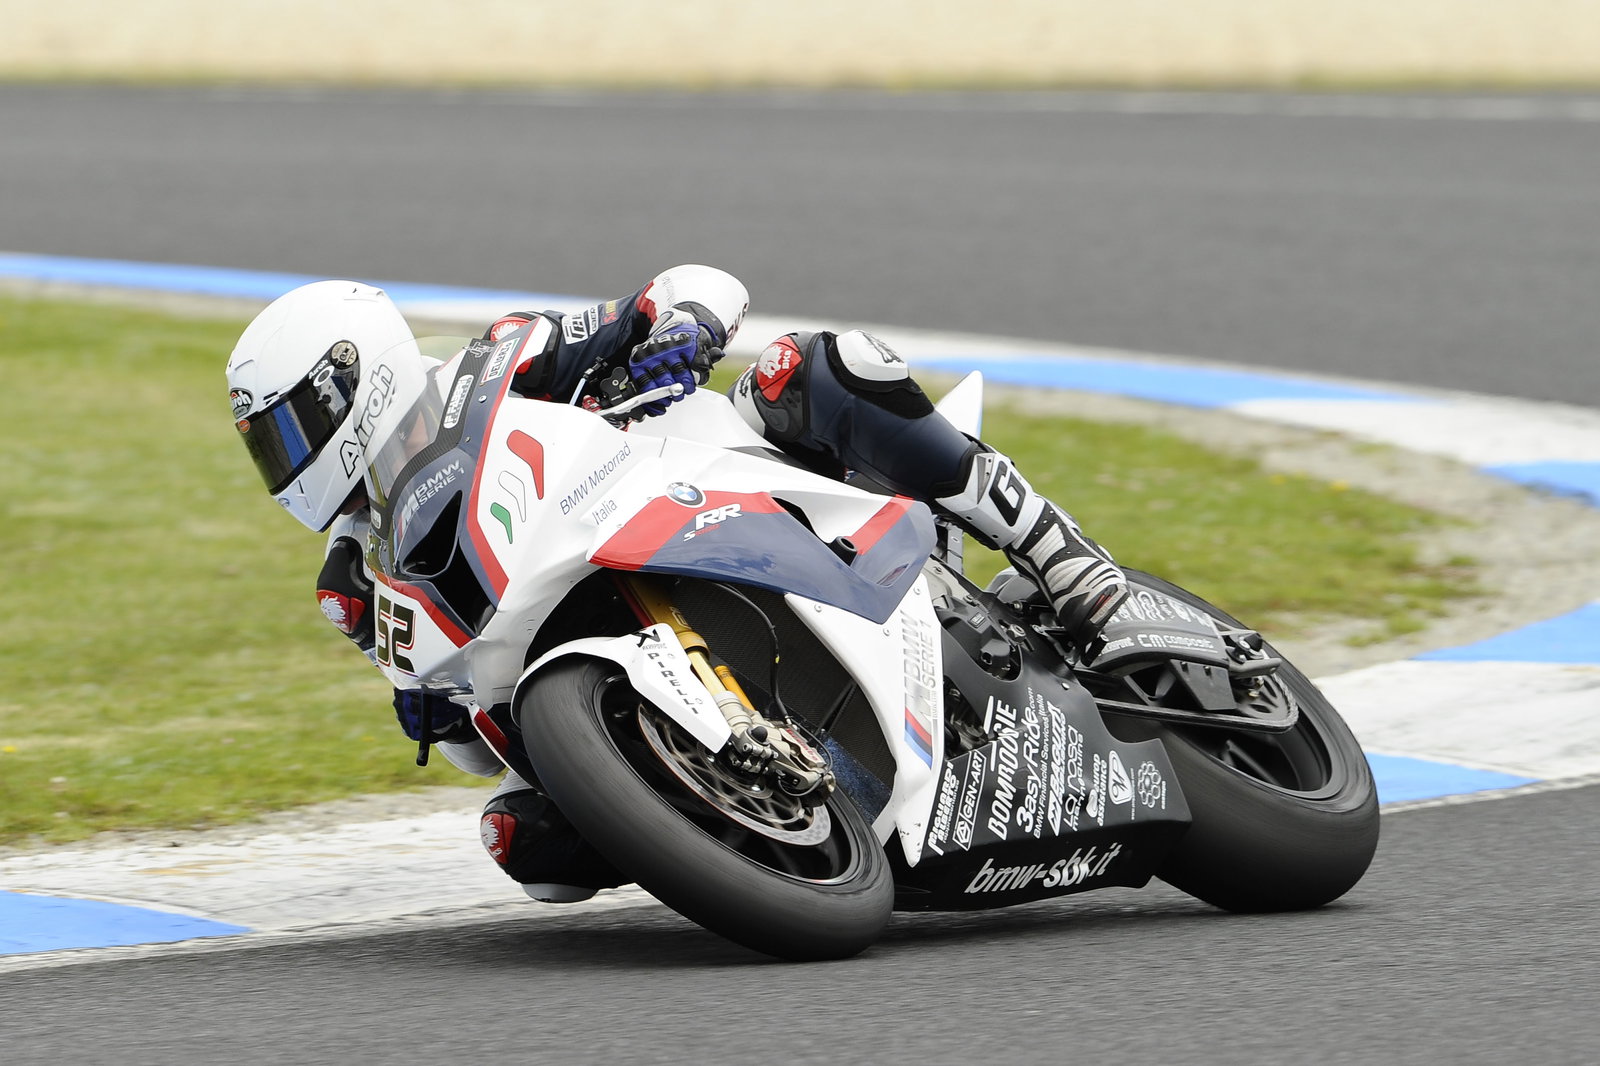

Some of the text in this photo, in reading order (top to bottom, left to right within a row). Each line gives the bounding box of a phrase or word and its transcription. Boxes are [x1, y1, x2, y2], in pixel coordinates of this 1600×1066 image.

[338, 363, 395, 480] Airoh
[415, 460, 460, 499] BMW
[418, 473, 456, 506] SERIE
[559, 441, 632, 516] BMW Motorrad
[591, 498, 618, 525] Italia
[695, 503, 743, 532] RR
[377, 593, 419, 677] 52
[920, 632, 937, 689] SERIE
[647, 652, 699, 714] PIRELLI
[1041, 716, 1049, 761] Services
[1067, 725, 1080, 792] rosa
[963, 750, 984, 819] GEN-ART
[1038, 762, 1049, 808] Financial
[1072, 734, 1084, 831] mannequins
[1092, 753, 1102, 792] europ
[1097, 759, 1108, 826] assistance
[937, 774, 957, 842] ALBERTO
[1033, 807, 1045, 840] BMW
